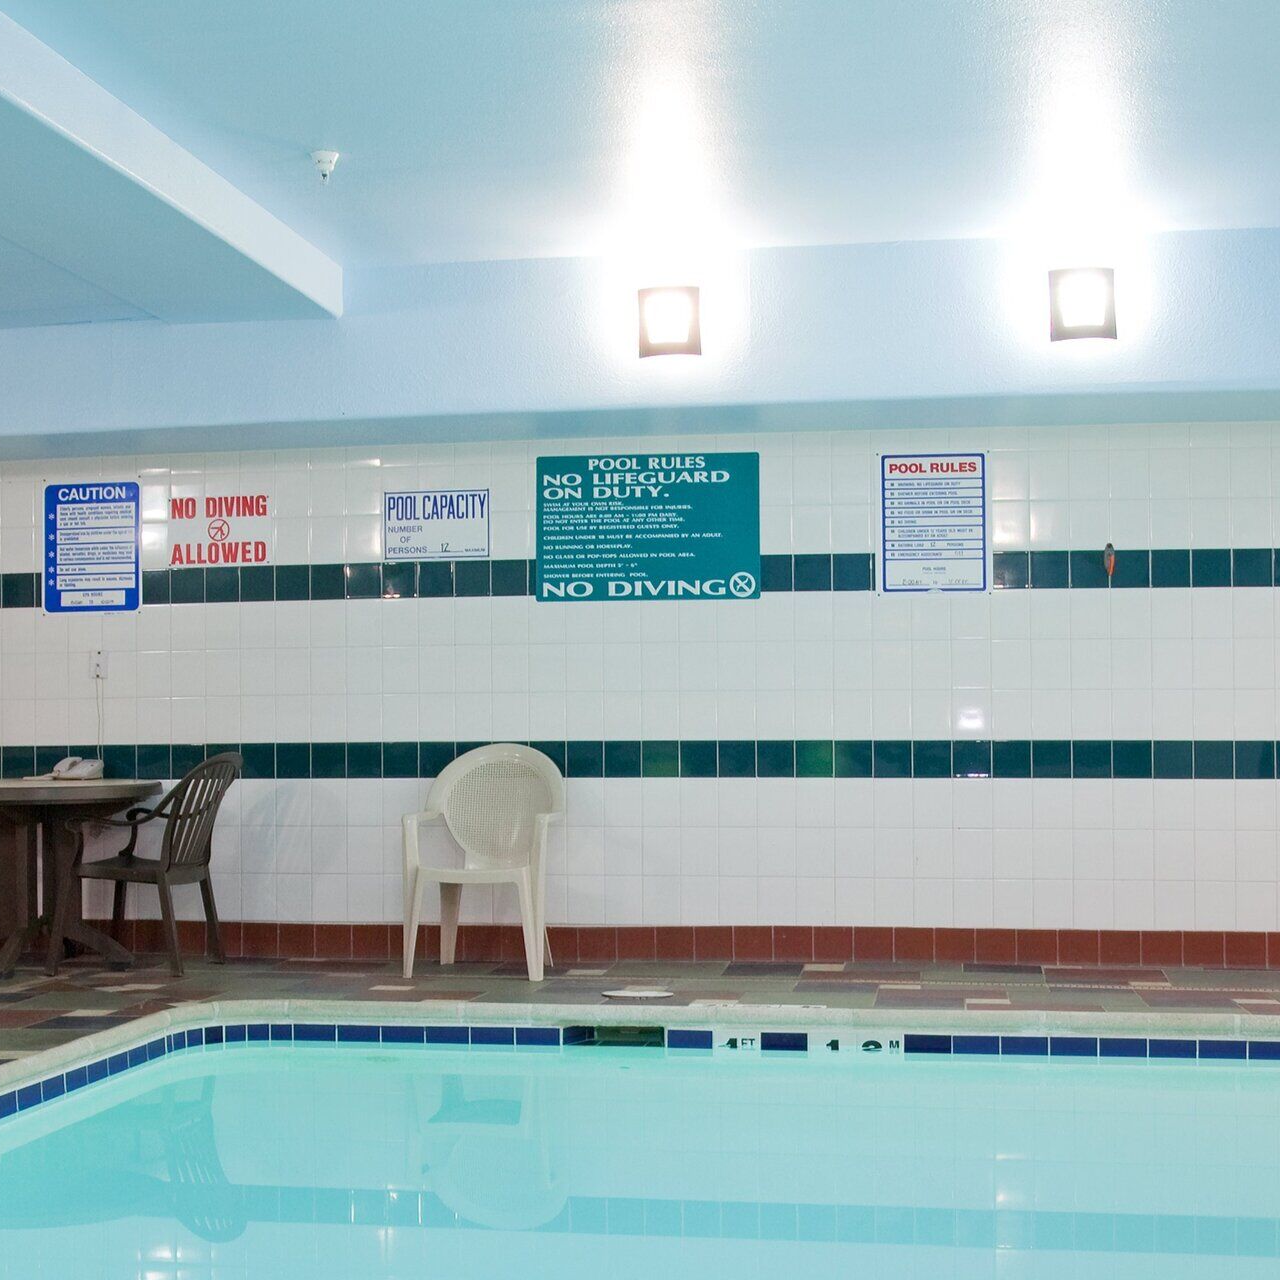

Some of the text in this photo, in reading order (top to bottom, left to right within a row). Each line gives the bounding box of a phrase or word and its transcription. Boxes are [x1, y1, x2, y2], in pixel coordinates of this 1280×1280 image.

[588, 456, 706, 471] POOL RULES
[889, 461, 978, 474] POOL RULES
[543, 470, 730, 486] NO LIFEGUARD
[58, 486, 126, 501] CAUTION
[543, 485, 670, 500] ON DUTY.
[171, 495, 268, 520] NO DIVING
[387, 493, 487, 521] POOL CAPACITY
[387, 525, 423, 534] NUMBER
[399, 536, 412, 544] OF
[171, 541, 267, 565] ALLOWED
[387, 545, 428, 555] PERSONS
[543, 579, 726, 598] NO DIVING
[741, 1038, 756, 1047] FT
[889, 1040, 900, 1049] M
